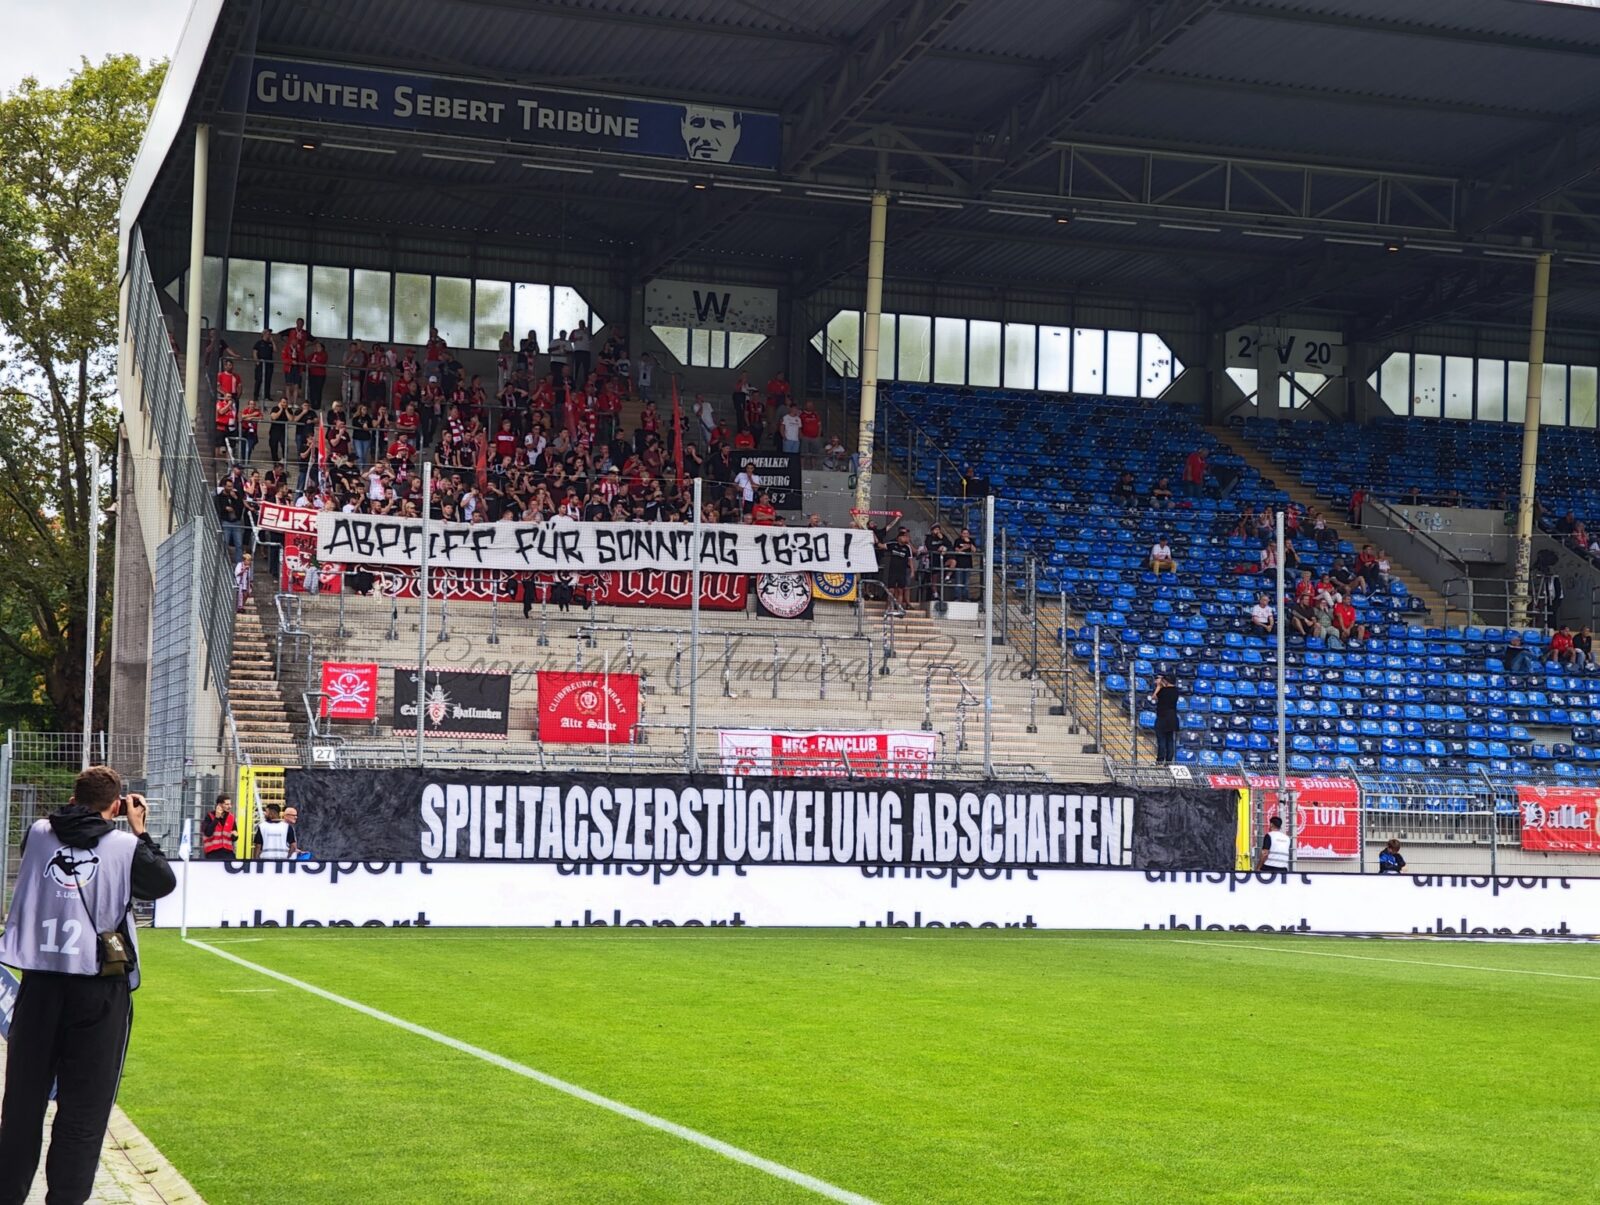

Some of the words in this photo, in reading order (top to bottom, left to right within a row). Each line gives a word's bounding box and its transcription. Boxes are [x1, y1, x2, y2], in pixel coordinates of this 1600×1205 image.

[256, 70, 379, 111] GÜNTER
[393, 85, 506, 124] SEBERT
[517, 99, 640, 139] TRIBÜNE
[693, 290, 731, 322] W
[1238, 336, 1258, 358] 2
[1276, 336, 1296, 364] V
[1304, 342, 1331, 364] 20
[740, 457, 790, 469] DOMFALKEN
[323, 518, 496, 563] ABPFIFF
[515, 523, 584, 564] FÜR
[596, 529, 739, 566] SONNTAG
[843, 533, 853, 568] !
[549, 680, 598, 713] CLUBFREUNDE
[560, 717, 583, 728] Alte
[316, 748, 332, 759] 27
[735, 747, 759, 757] HFC
[782, 738, 808, 753] HFC
[818, 737, 878, 753] FANCLUB
[895, 748, 927, 760] HFC
[1175, 766, 1189, 777] 26
[1216, 776, 1243, 786] Rot
[420, 776, 902, 863] SPIELTAGSZERSTÜCKELUNG
[911, 791, 1135, 866] ABSCHAFFEN!
[1520, 800, 1591, 832] Halle
[40, 917, 82, 955] 12
